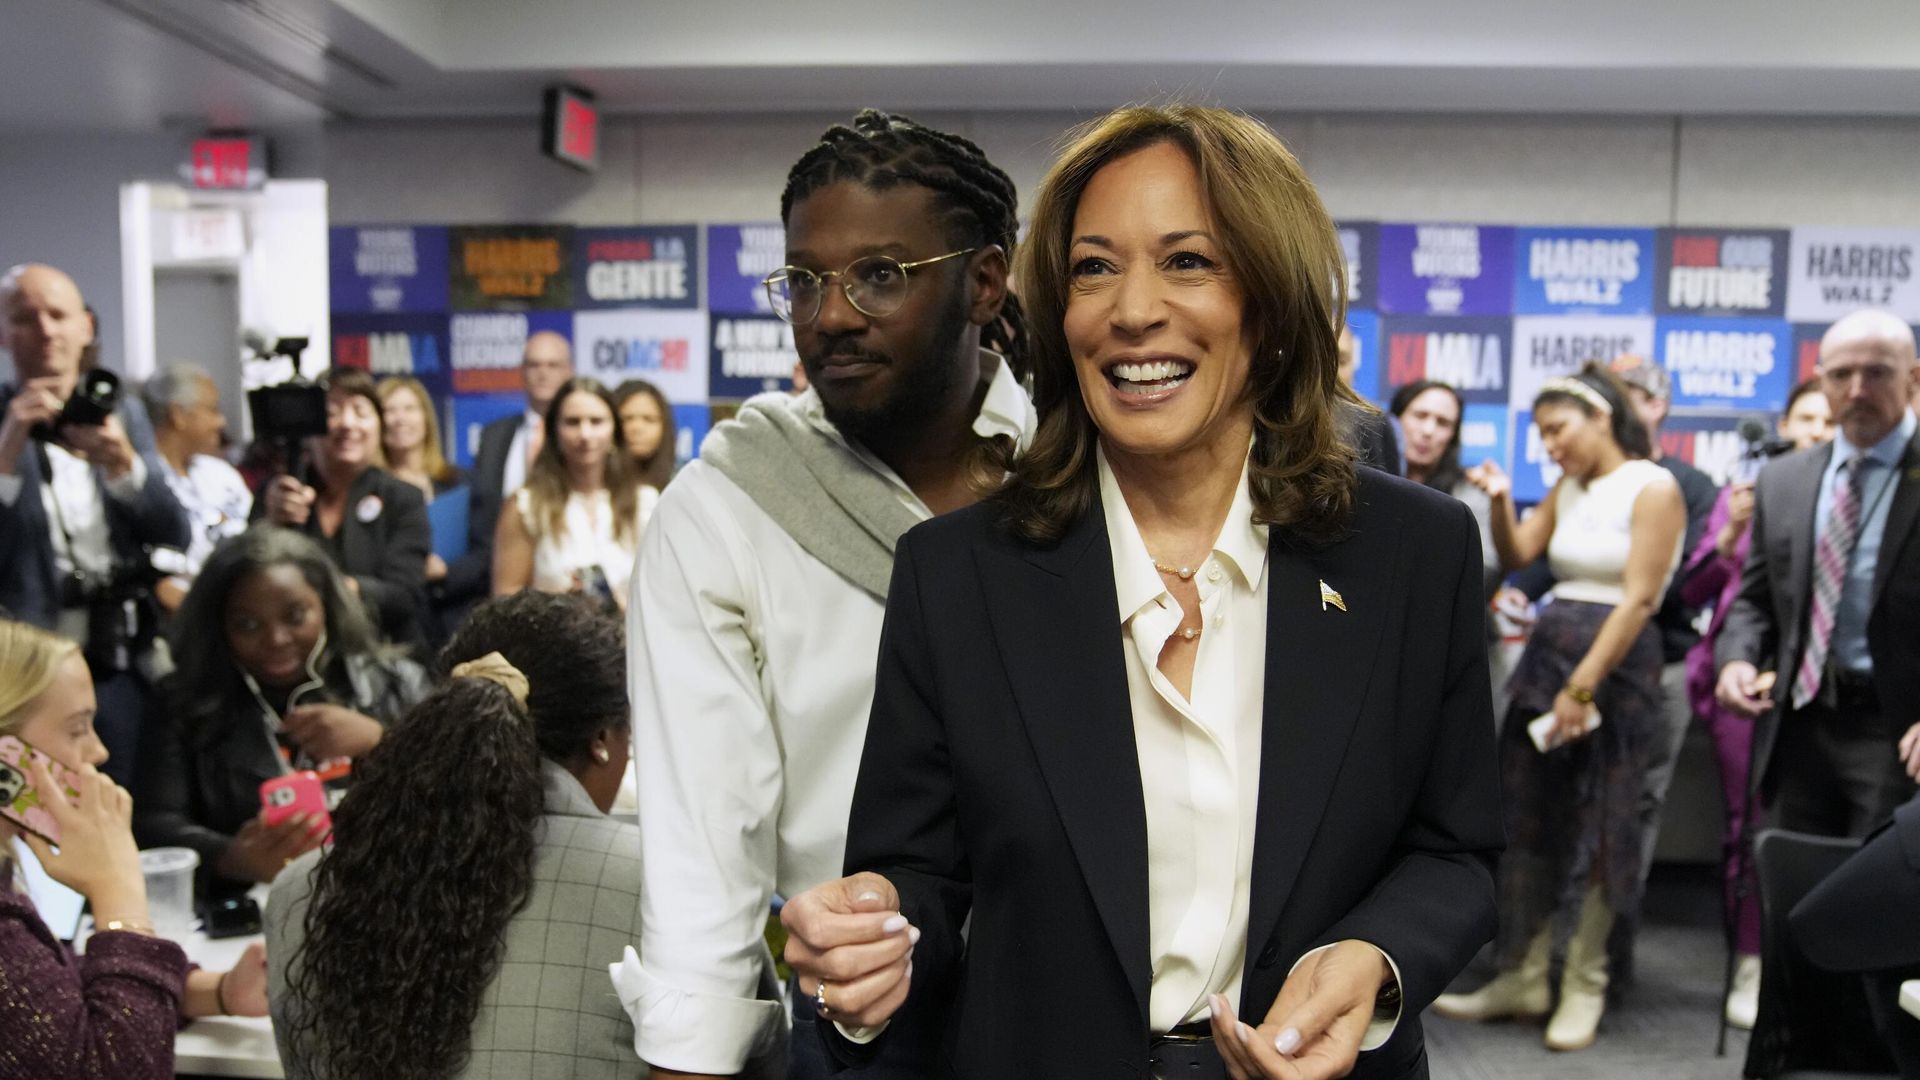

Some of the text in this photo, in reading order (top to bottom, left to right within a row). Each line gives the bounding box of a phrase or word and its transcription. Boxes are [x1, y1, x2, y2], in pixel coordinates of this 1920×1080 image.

[1411, 251, 1482, 279] VOTERS
[1529, 237, 1640, 281] HARRIS
[1806, 243, 1914, 279] HARRIS
[586, 261, 689, 301] GENTE
[1543, 279, 1623, 305] WALZ
[1668, 266, 1773, 309] FUTURE
[1822, 284, 1895, 305] WALZ
[335, 331, 439, 374] KAMALA
[1387, 331, 1503, 390] KAMALA
[1664, 329, 1776, 374] HARRIS
[1680, 371, 1758, 398] WALZ
